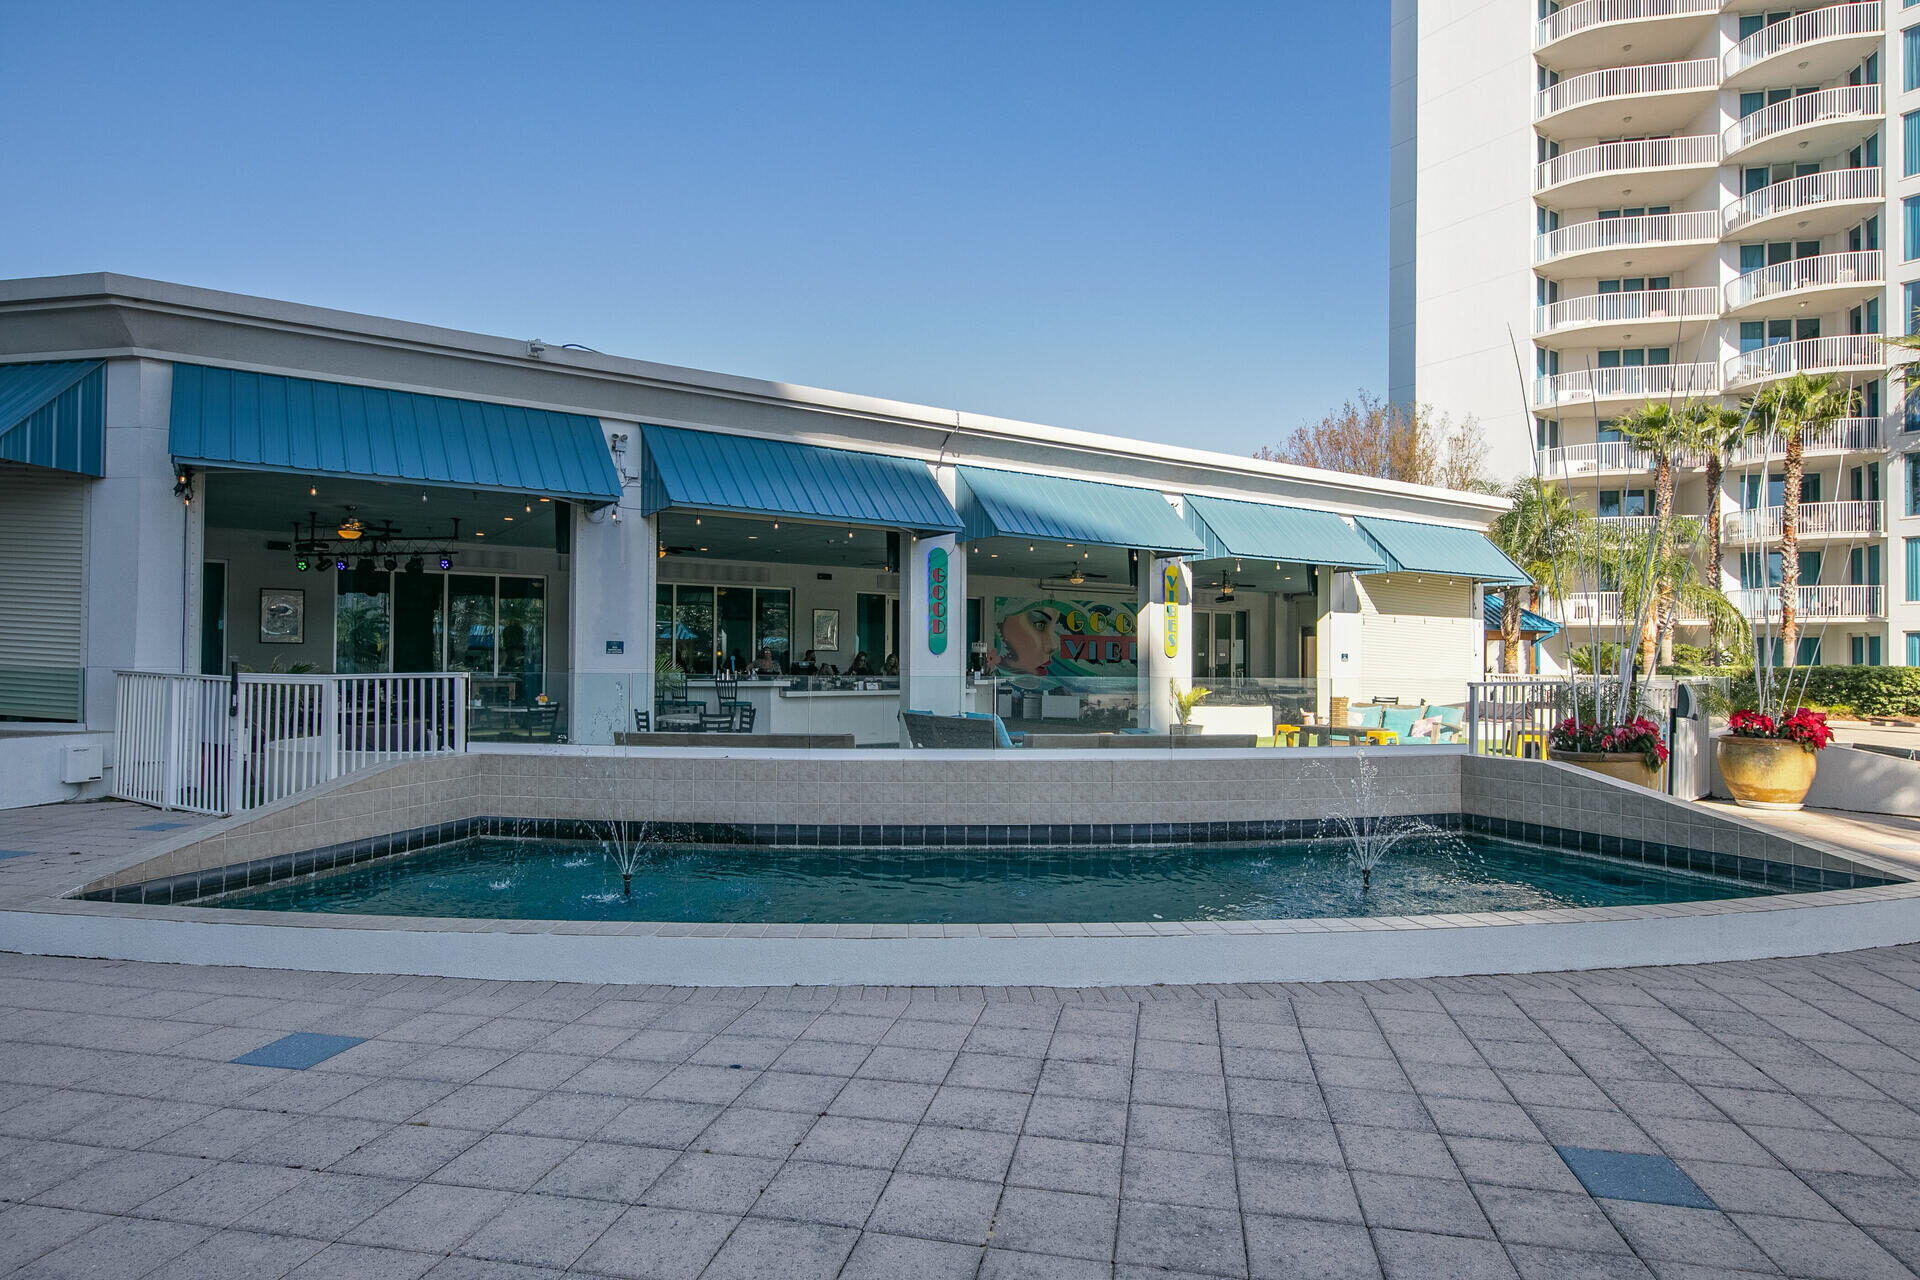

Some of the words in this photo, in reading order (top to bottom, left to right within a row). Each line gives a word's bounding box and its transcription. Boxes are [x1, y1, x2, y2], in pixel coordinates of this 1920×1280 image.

[932, 567, 946, 634] GOOD
[1066, 610, 1134, 634] GOO
[1166, 575, 1178, 647] VIBES
[1064, 639, 1137, 662] VIB
